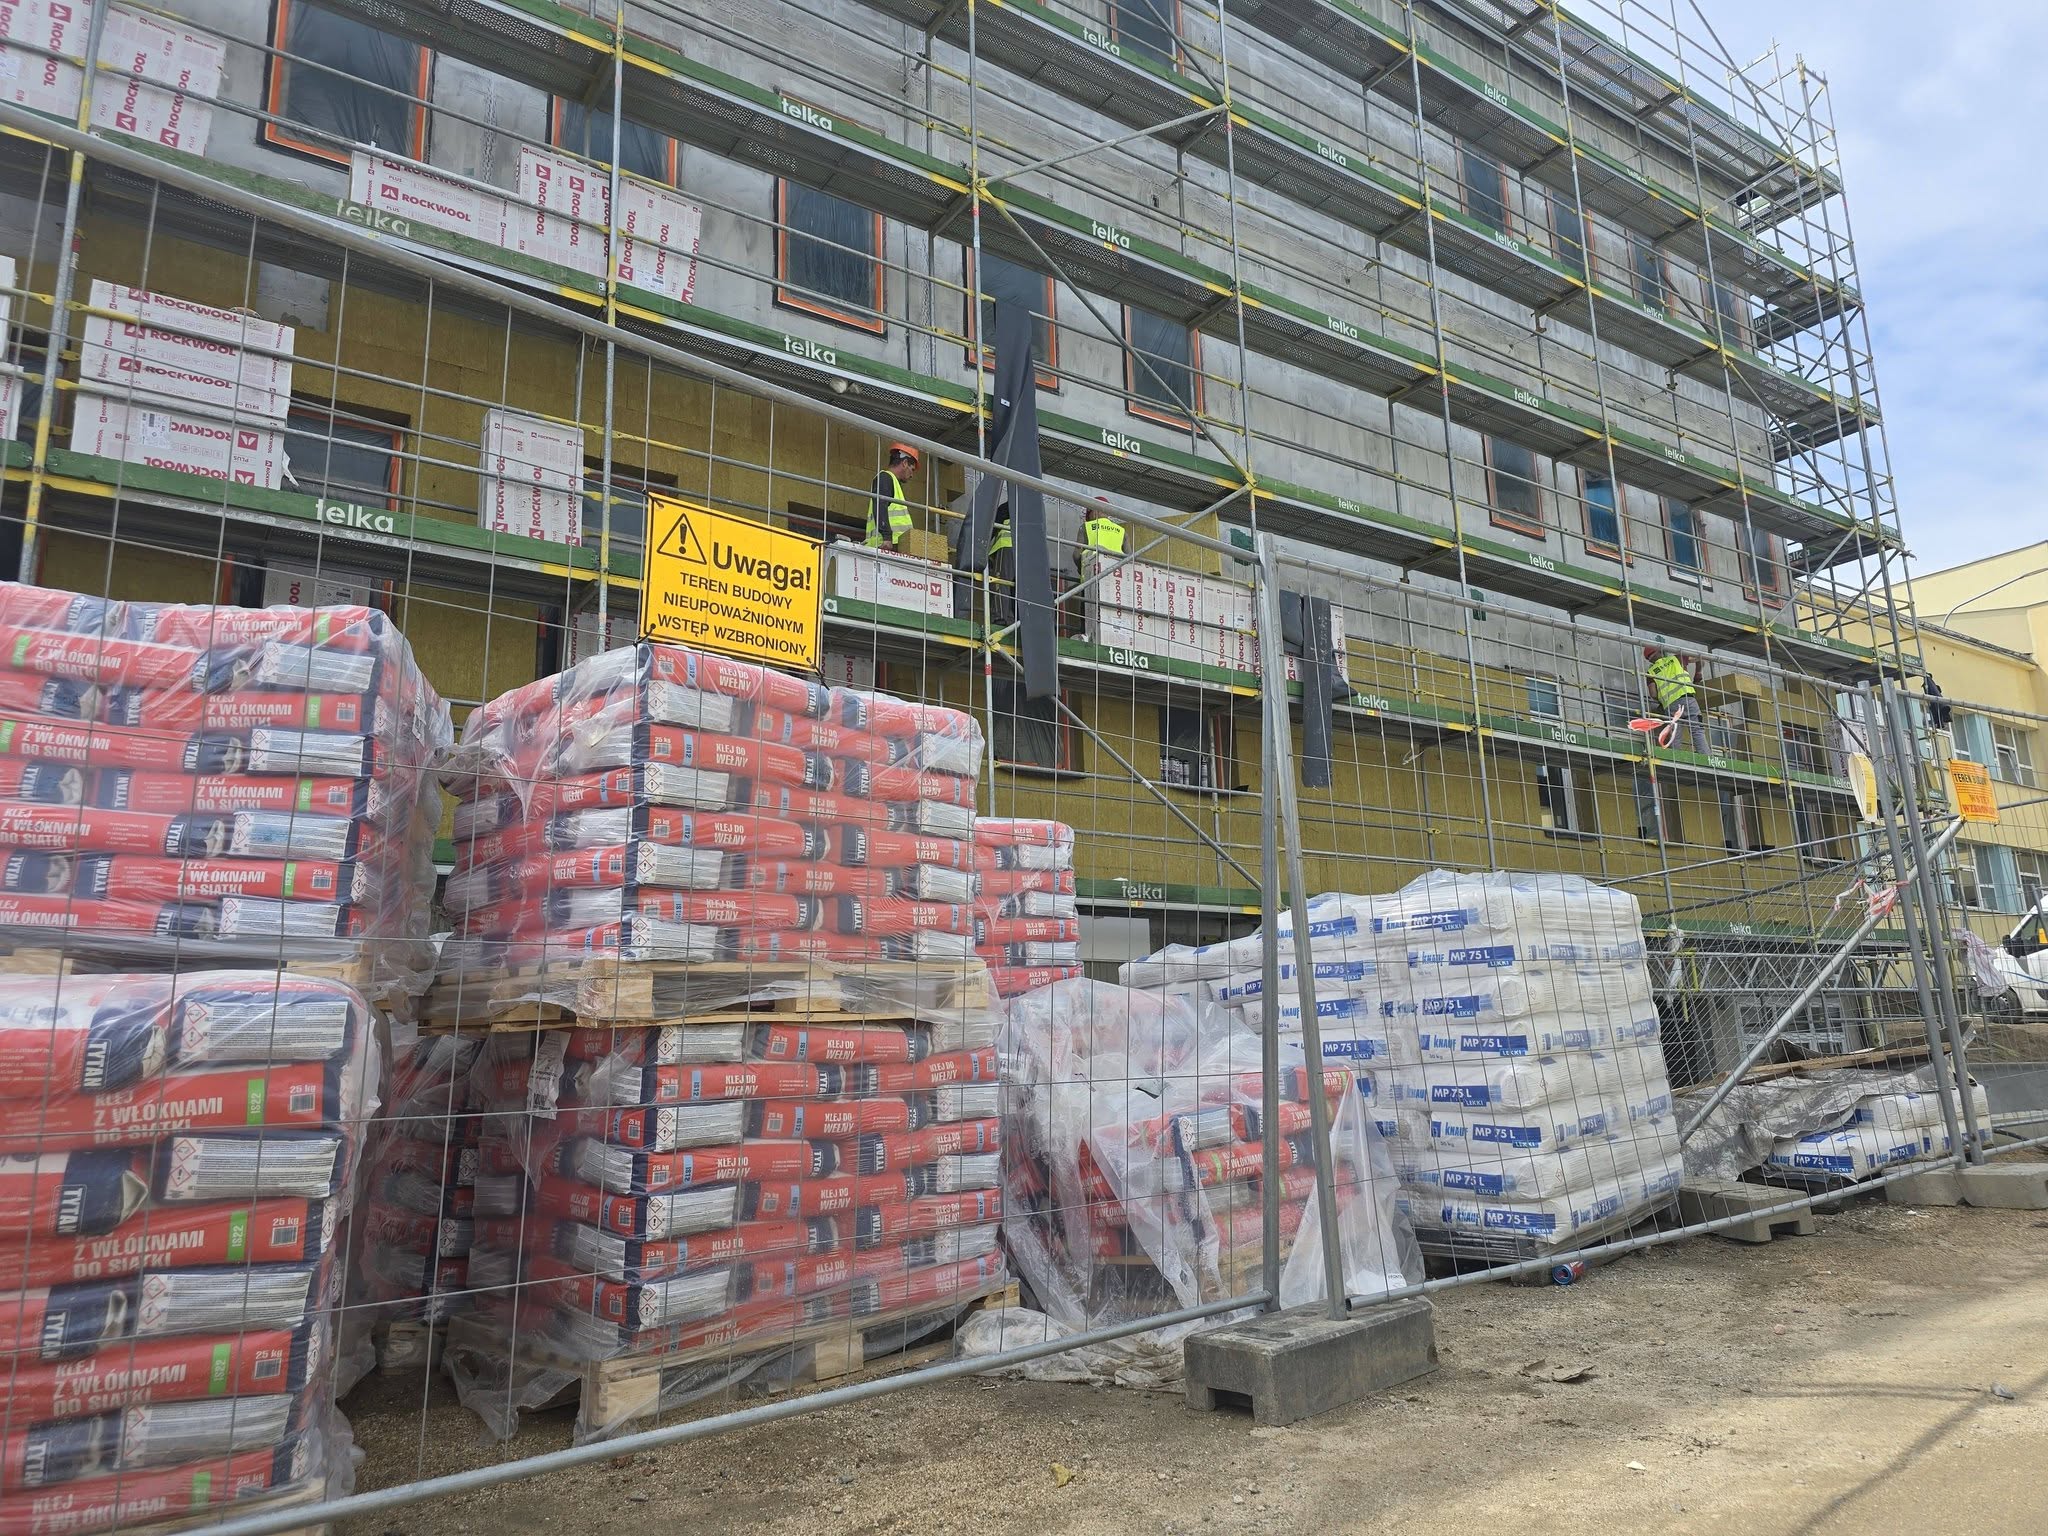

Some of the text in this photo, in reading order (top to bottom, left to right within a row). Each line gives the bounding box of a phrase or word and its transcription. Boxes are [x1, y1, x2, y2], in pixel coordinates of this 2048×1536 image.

[1083, 27, 1120, 57] telka
[1484, 83, 1508, 107] telka
[781, 97, 833, 132] telka
[1317, 142, 1347, 167] telka
[1626, 167, 1648, 185] telka
[402, 194, 471, 222] ROCKWOOL
[336, 199, 411, 238] telka
[1092, 221, 1130, 249] telka
[1495, 229, 1520, 252] telka
[154, 295, 240, 323] ROCKWOOL
[1643, 303, 1665, 321] telka
[1328, 316, 1358, 339] telka
[151, 329, 236, 356] ROCKWOOL
[784, 334, 836, 366] telka
[144, 365, 232, 389] ROCKWOOL
[1514, 387, 1540, 409] telka
[1102, 429, 1141, 454] telka
[1664, 449, 1685, 463] telka
[1338, 498, 1360, 514] telka
[1789, 494, 1807, 510] telka
[316, 499, 394, 533] telka
[1101, 525, 1120, 533] SIGVIN
[713, 542, 811, 591] Uwaga!
[1528, 553, 1555, 572] telka
[680, 572, 792, 609] TEREN BUDOWY
[664, 592, 804, 634] NIEUPOWAŻNIONYM
[1680, 597, 1702, 613] telka
[658, 614, 806, 656] WSTĘP WZBRONIONY
[1810, 633, 1829, 647] telka
[36, 647, 122, 669] Z WŁÓKNAMI
[1109, 647, 1149, 670] telka
[35, 659, 99, 677] DO SIATKI
[719, 666, 749, 680] KLEJ DO
[719, 676, 751, 691] WEŁNY
[806, 687, 817, 713] TYTAN
[1357, 692, 1389, 711] telka
[208, 704, 292, 715] Z WŁÓKNAMI
[208, 717, 271, 728] DO SIATKI
[22, 730, 110, 750] Z WŁÓKNAMI
[1551, 728, 1577, 745] telka
[21, 743, 87, 761] DO SIATKI
[716, 743, 746, 755] KLEJ DO
[716, 754, 748, 768] WEŁNY
[805, 757, 814, 784] TYTAN
[115, 776, 129, 808] TYTAN
[197, 785, 283, 798] Z WŁÓKNAMI
[4, 808, 32, 817] KLEJ
[0, 818, 91, 836] Z WŁÓKNAMI
[714, 822, 745, 834] KLEJ DO
[0, 833, 67, 848] DO SIATKI
[166, 823, 184, 853] TYTAN
[714, 832, 746, 846] WEŁNY
[856, 832, 866, 861] TYTAN
[5, 856, 24, 887] TYTAN
[93, 860, 111, 892] TYTAN
[191, 870, 265, 883] WŁÓKNAMI
[1121, 881, 1162, 900] telka
[853, 902, 862, 930] TYTAN
[1315, 923, 1335, 932] 75 L
[1422, 951, 1445, 966] KNAUF
[1451, 952, 1466, 961] MP
[1469, 951, 1482, 959] 75
[1317, 966, 1331, 974] MP
[1320, 1004, 1332, 1012] 75
[1333, 1003, 1339, 1011] L
[1425, 1000, 1462, 1011] MP L
[827, 1039, 854, 1050] KLEJ DO
[1325, 1043, 1352, 1052] MP 75
[1434, 1035, 1502, 1050] KNAUF MP 75 L
[83, 1040, 109, 1087] TYTAN
[826, 1050, 855, 1060] WEŁNY
[725, 1074, 756, 1084] KLEJ DO
[289, 1085, 303, 1094] 25
[725, 1085, 758, 1096] WEŁNY
[1434, 1089, 1472, 1098] MP 75 L
[251, 1091, 262, 1114] IS22
[93, 1097, 223, 1128] Z WŁÓKNAMI
[825, 1113, 853, 1122] KLEJ DO
[824, 1123, 854, 1134] WEŁNY
[1445, 1122, 1516, 1139] KNAUF MP 75 L
[717, 1157, 749, 1167] KLEJ DO
[716, 1168, 750, 1179] WEŁNY
[821, 1188, 849, 1198] KLEJ DO
[57, 1188, 83, 1233] TYTAN
[820, 1198, 851, 1210] WEŁNY
[232, 1224, 244, 1248] IS22
[74, 1230, 204, 1261] Z WŁÓKNAMI
[73, 1253, 172, 1279] DO SIATKI
[56, 1360, 96, 1377] KLEJ
[53, 1364, 187, 1398] Z WŁÓKNAMI
